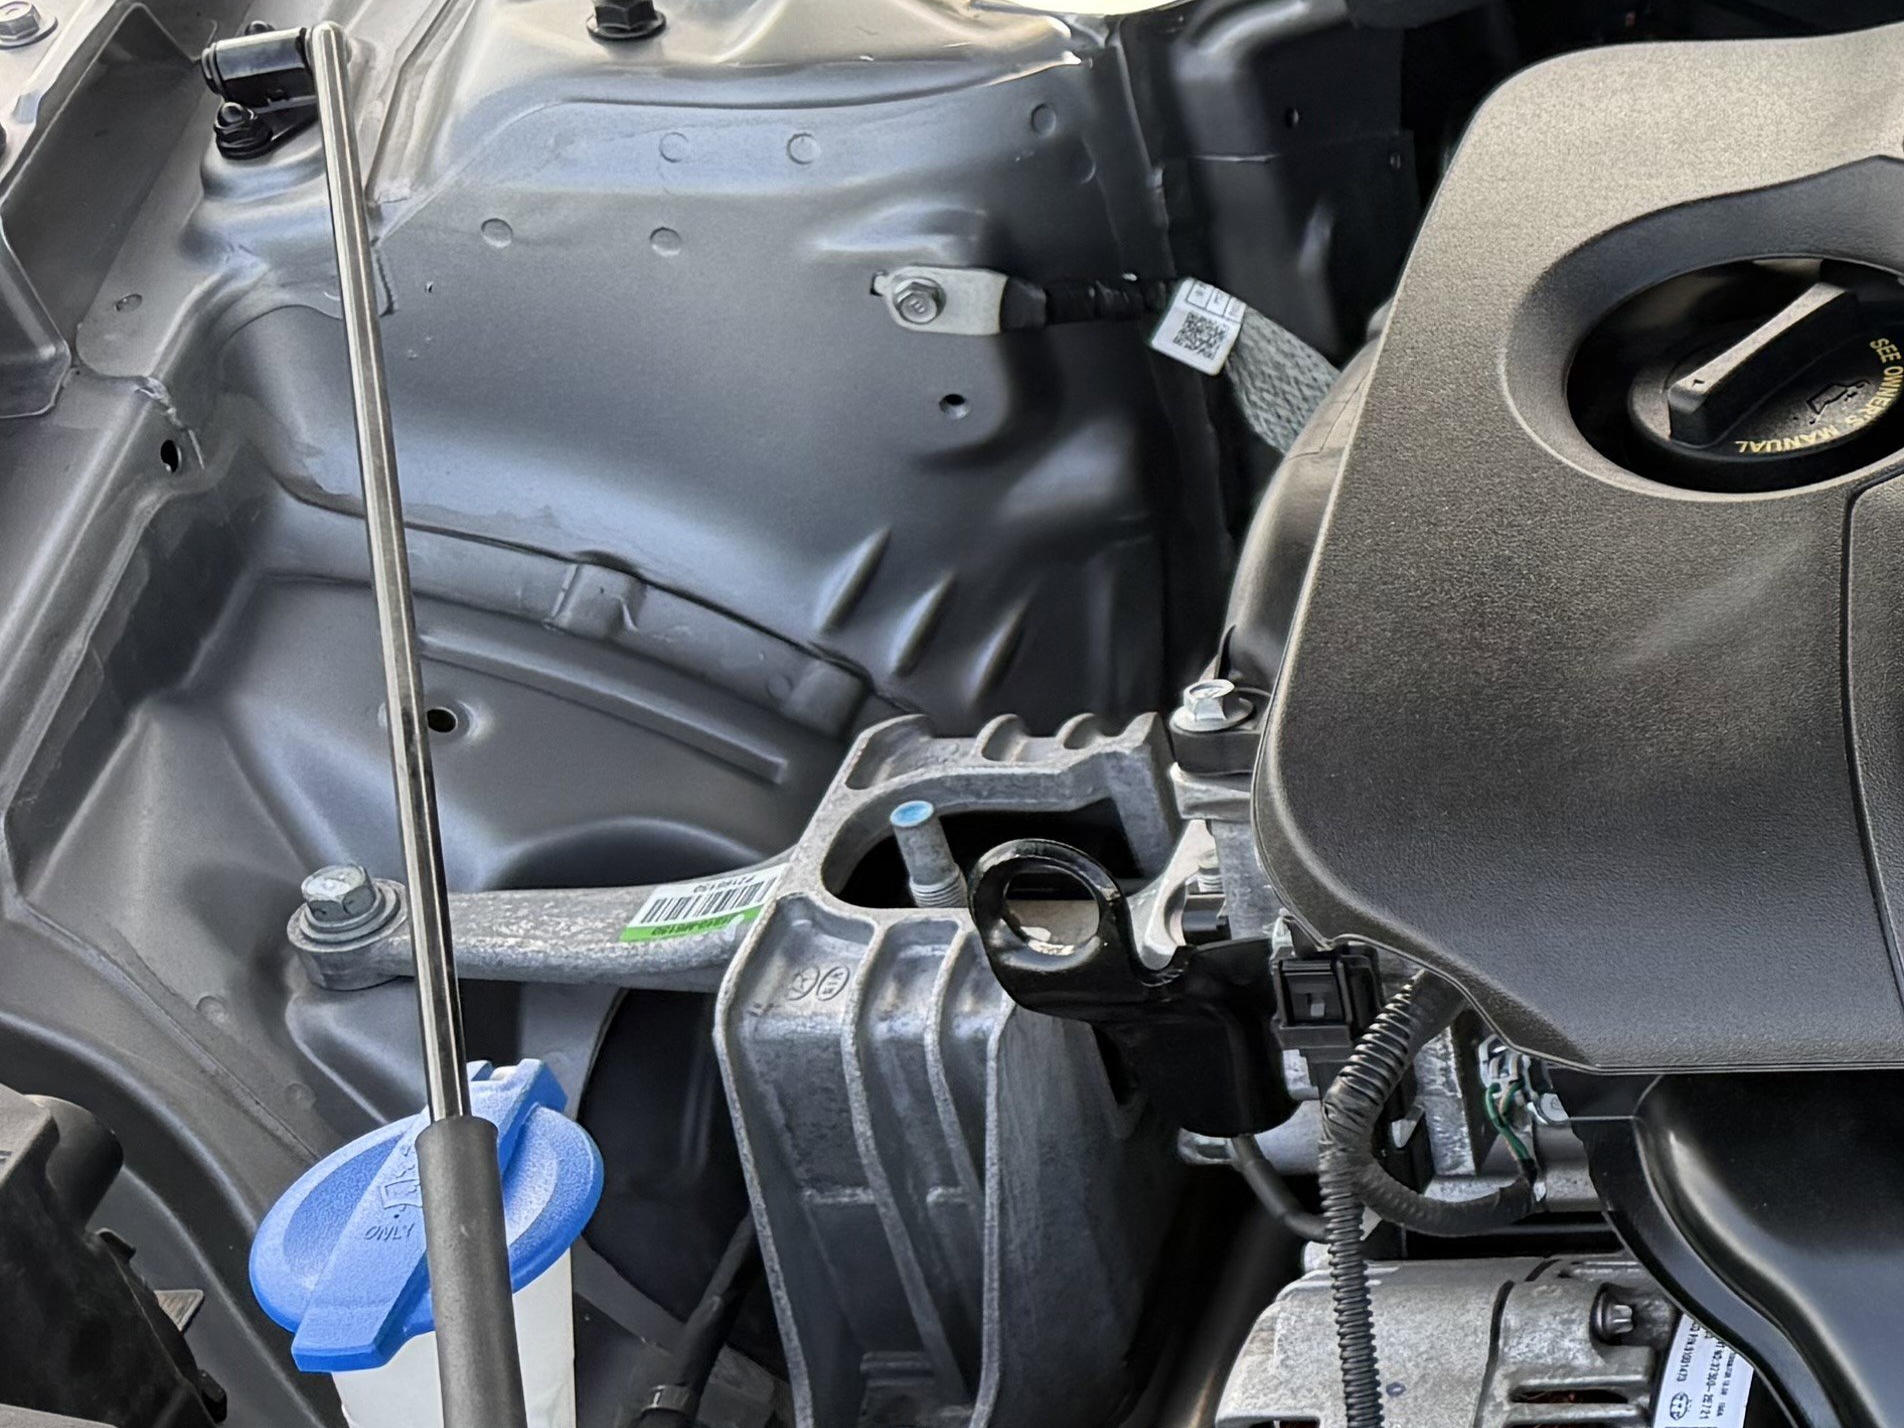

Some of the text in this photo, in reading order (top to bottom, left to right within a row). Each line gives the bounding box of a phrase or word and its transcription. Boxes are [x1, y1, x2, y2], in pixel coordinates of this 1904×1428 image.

[1734, 337, 1904, 453] SEE OWNER'S MANUAL
[364, 1223, 415, 1242] ONLY
